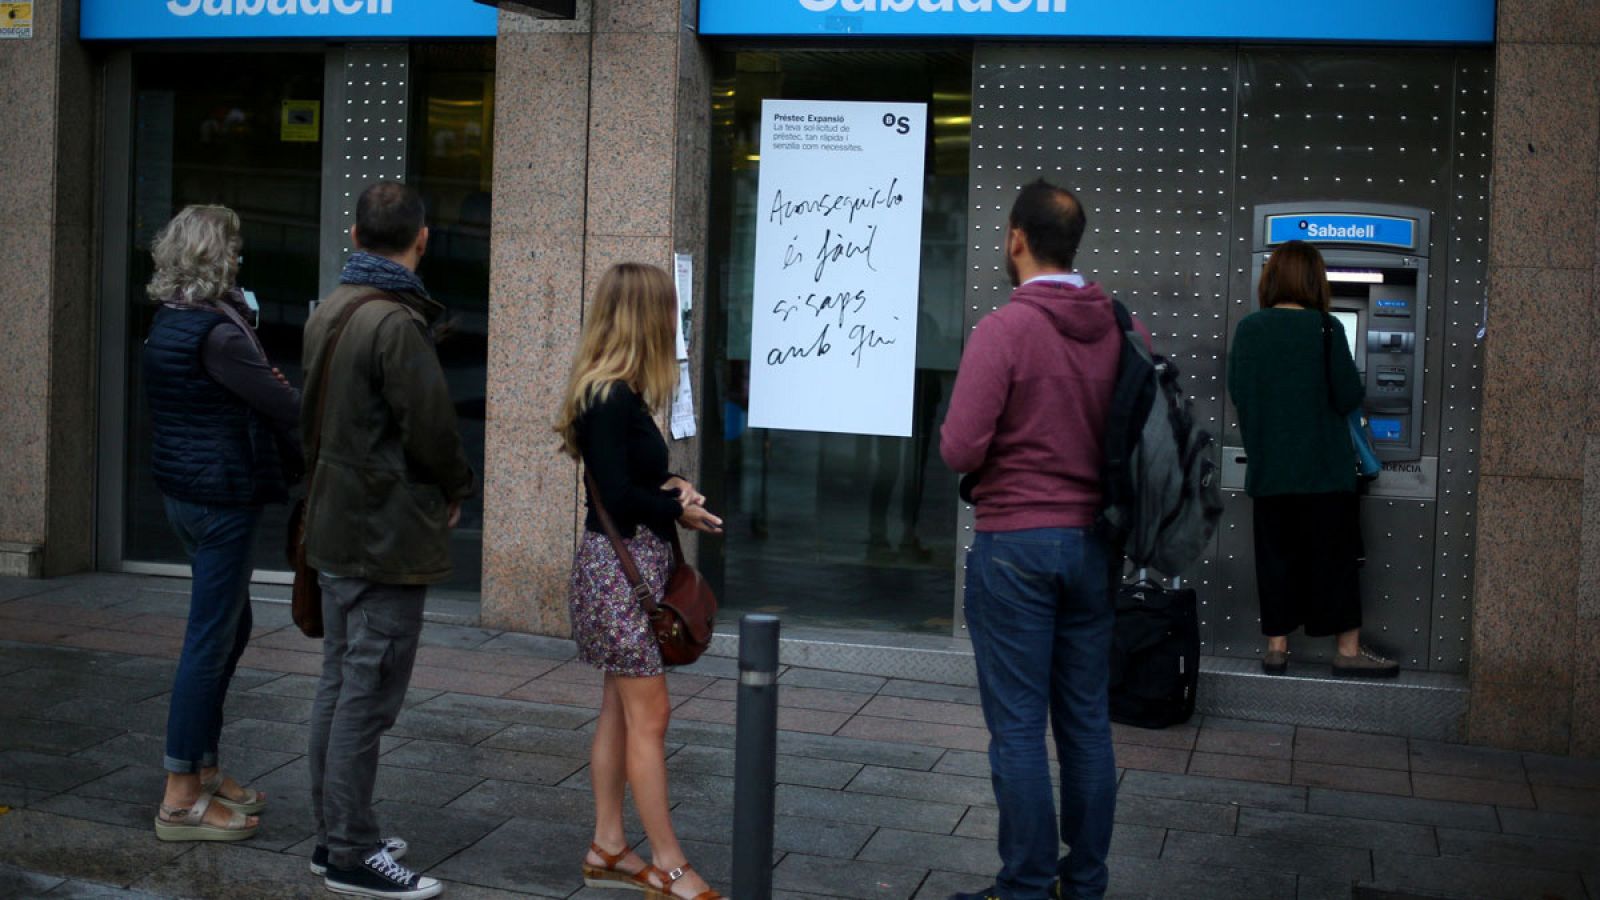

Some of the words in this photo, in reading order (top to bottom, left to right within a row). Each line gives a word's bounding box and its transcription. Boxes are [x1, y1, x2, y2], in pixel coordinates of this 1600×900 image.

[774, 113, 805, 122] Préstec
[808, 114, 845, 124] Expansió
[773, 123, 783, 131] La
[785, 124, 801, 132] teva
[840, 124, 850, 133] de
[805, 133, 818, 141] tan
[1307, 223, 1375, 238] Sabadell
[767, 323, 832, 366] amb
